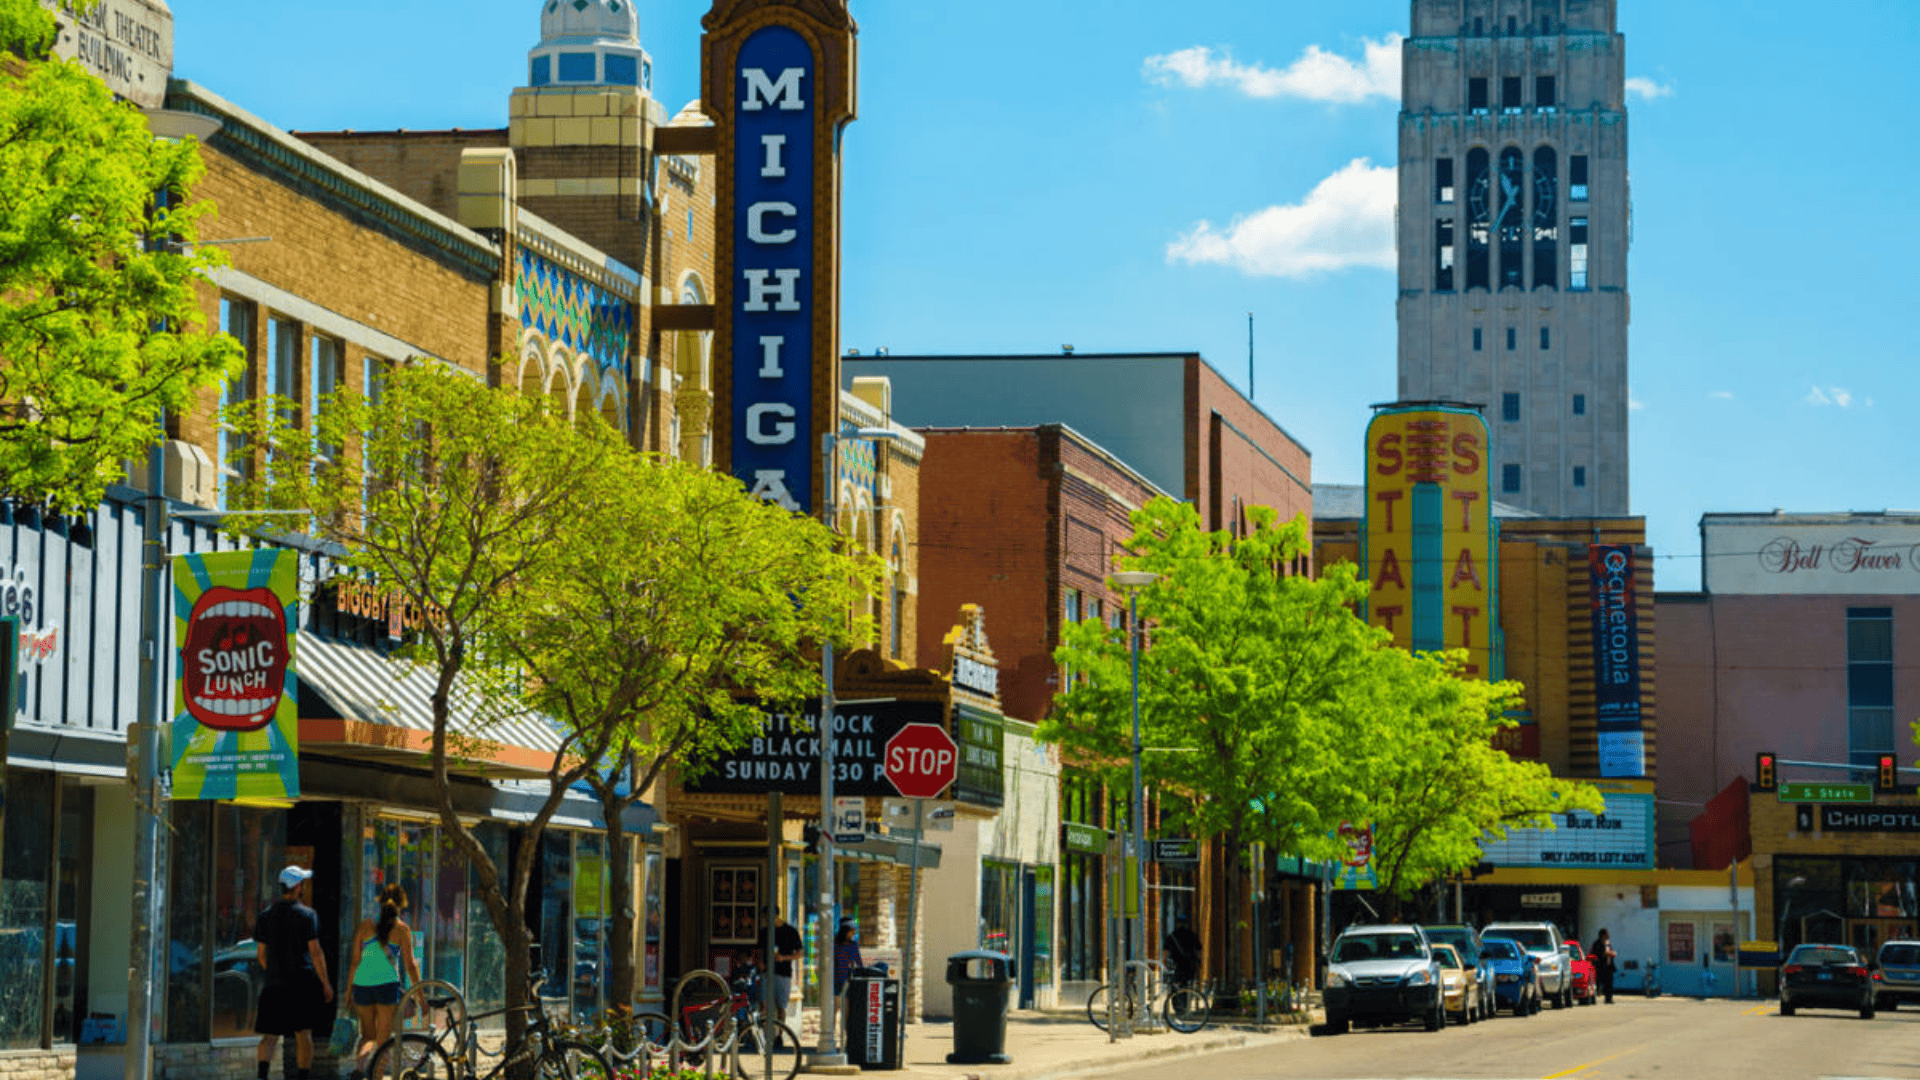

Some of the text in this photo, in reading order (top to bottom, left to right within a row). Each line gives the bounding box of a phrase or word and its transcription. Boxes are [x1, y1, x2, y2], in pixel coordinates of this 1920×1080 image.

[114, 9, 161, 60] THEATER
[77, 30, 132, 83] BUILDING
[741, 67, 805, 511] MICHIGA
[1374, 431, 1405, 649] STAT
[1450, 431, 1482, 675] STAT
[337, 580, 389, 622] BIGGBY
[1607, 576, 1630, 685] cinetopia
[198, 640, 275, 675] SONIC
[204, 670, 267, 696] LUNCH
[753, 713, 874, 734] HITHOCK
[725, 761, 811, 781] SUNDAY
[889, 746, 952, 776] STOP
[1819, 787, 1856, 799] State
